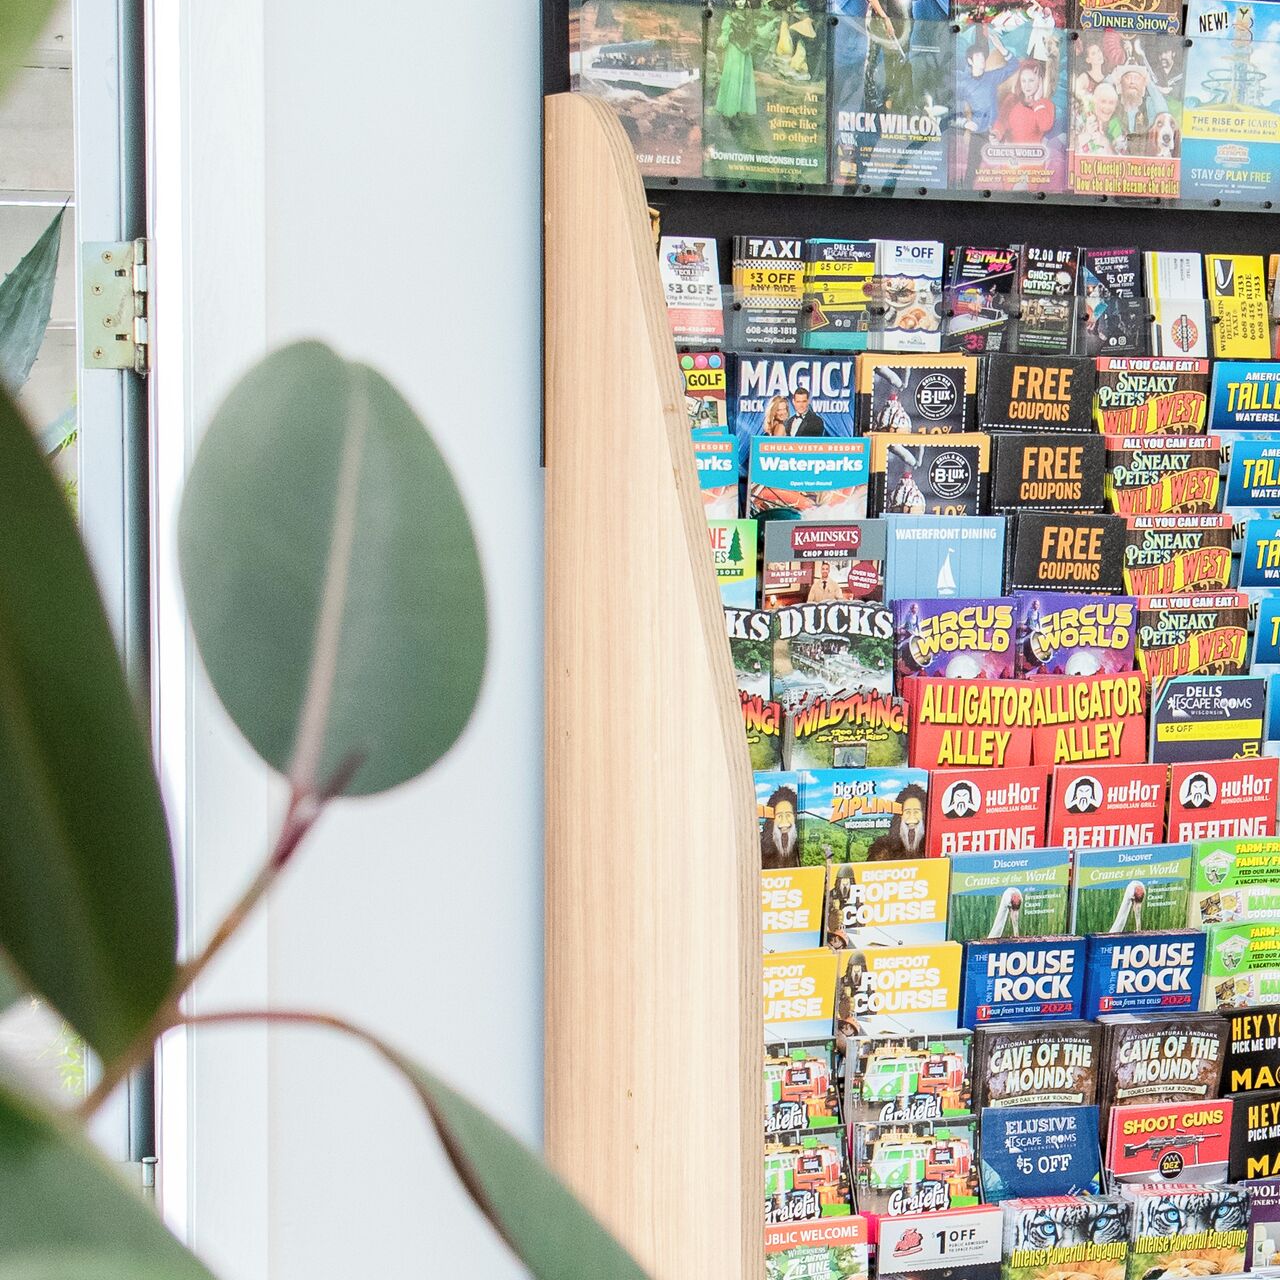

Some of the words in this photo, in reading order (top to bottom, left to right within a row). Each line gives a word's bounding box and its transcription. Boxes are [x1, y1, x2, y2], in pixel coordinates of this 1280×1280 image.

[1092, 12, 1134, 28] DINNER
[1136, 16, 1169, 31] SHOW
[1198, 11, 1229, 33] NEW!
[767, 103, 818, 116] interactive
[769, 119, 796, 130] game
[799, 119, 818, 130] like
[838, 111, 876, 132] RICK
[878, 114, 942, 137] WILCOX
[773, 134, 788, 143] no
[713, 151, 755, 164] DOWNTOWN
[756, 154, 795, 166] WISCONSIN
[797, 157, 818, 168] DELLS
[1191, 168, 1213, 180] STAY
[1226, 171, 1249, 182] PLAY
[1250, 172, 1272, 183] FREE
[749, 240, 801, 259] TAXI
[911, 245, 935, 259] OFF
[1056, 250, 1072, 263] OFF
[750, 272, 764, 283] $3
[767, 273, 796, 284] OFF
[1028, 269, 1054, 280] GHOST
[750, 284, 770, 293] ANY
[774, 284, 797, 293] RIDE
[1023, 280, 1056, 291] OUTPOST
[745, 326, 797, 335] 608-448-1818
[688, 373, 722, 387] GOLF
[1010, 365, 1073, 401] FREE
[1009, 401, 1070, 420] COUPONS
[828, 444, 861, 452] RESORT
[759, 456, 864, 475] Waterparks
[794, 528, 859, 546] KAMINSKI'S
[895, 528, 961, 541] WATERFRONT
[961, 528, 997, 540] DINING
[802, 549, 822, 558] CHOP
[824, 549, 849, 557] HOUSE
[779, 601, 895, 640] DUCKS
[1186, 685, 1223, 698] DELLS
[920, 684, 1032, 726] ALLIGATOR
[938, 730, 1010, 765] ALLEY
[1063, 824, 1154, 848] BEATING
[993, 857, 1029, 869] Discover
[862, 867, 918, 880] BIGFOOT
[849, 879, 929, 904] ROPES
[986, 949, 1075, 977] HOUSE
[993, 975, 1073, 1001] ROCK
[1041, 1003, 1073, 1014] 2024
[990, 1047, 1034, 1073] CAVE
[1038, 1046, 1059, 1066] OF
[1061, 1043, 1093, 1068] THE
[1004, 1068, 1076, 1093] MOUNDS
[1124, 1116, 1178, 1134] SHOOT
[1181, 1109, 1223, 1128] GUNS
